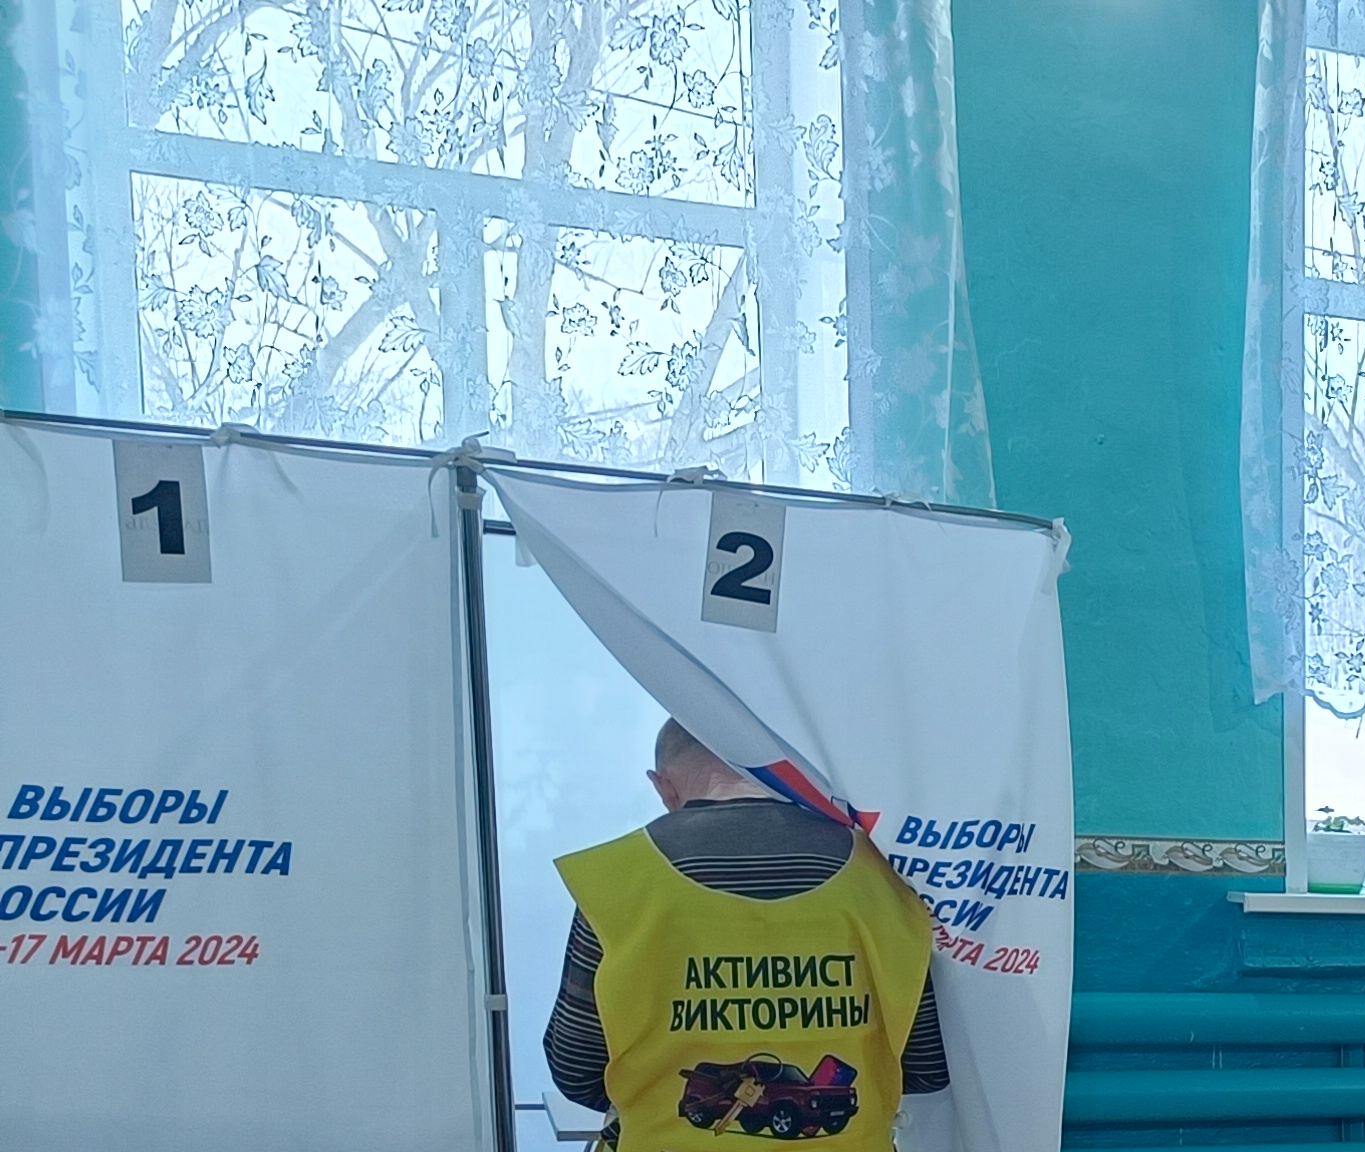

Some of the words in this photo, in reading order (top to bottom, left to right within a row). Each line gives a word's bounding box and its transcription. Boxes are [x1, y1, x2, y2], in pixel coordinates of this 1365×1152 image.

[131, 480, 185, 555] 1
[710, 531, 774, 605] 2
[7, 784, 229, 824] ВЫБОРЫ
[896, 815, 1036, 853] ВЫБОРЫ
[0, 834, 292, 879] ПРЕЗИДЕНТА
[888, 853, 1069, 900] ПРЕЗИДЕНТА
[0, 884, 167, 923] ОССИИ
[908, 885, 995, 932] СИИ
[48, 934, 170, 966] МАРТА
[175, 934, 260, 966] 2024
[982, 946, 1041, 975] 2024
[685, 955, 856, 990] АКТИВИСТ
[669, 993, 871, 1032] ВИКТОРИНЫ
